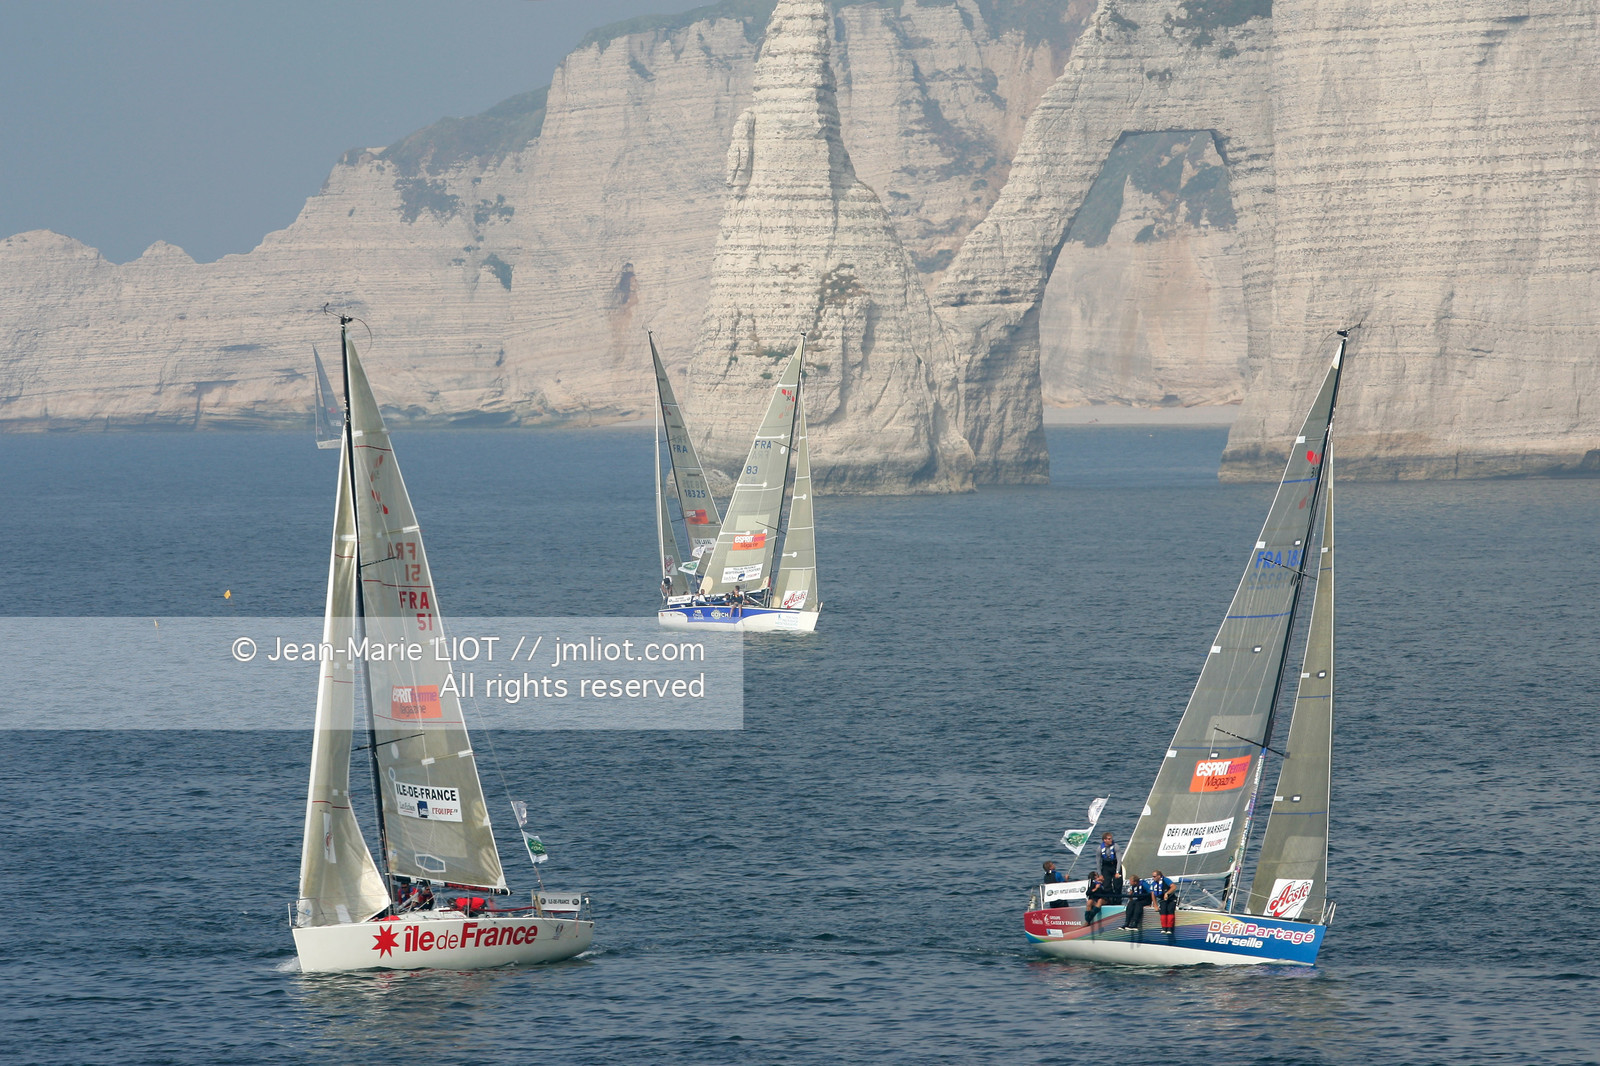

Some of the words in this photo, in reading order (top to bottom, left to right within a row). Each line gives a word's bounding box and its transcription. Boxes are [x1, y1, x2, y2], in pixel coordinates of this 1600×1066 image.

[673, 444, 688, 453] FRA
[755, 440, 772, 449] FRA
[746, 465, 758, 474] 83
[684, 489, 706, 498] 18325
[1255, 551, 1282, 568] FRA
[399, 591, 430, 609] FRA
[416, 613, 433, 631] 51
[1204, 776, 1237, 789] Magazine
[460, 922, 538, 948] France
[1205, 932, 1264, 948] Marseille
